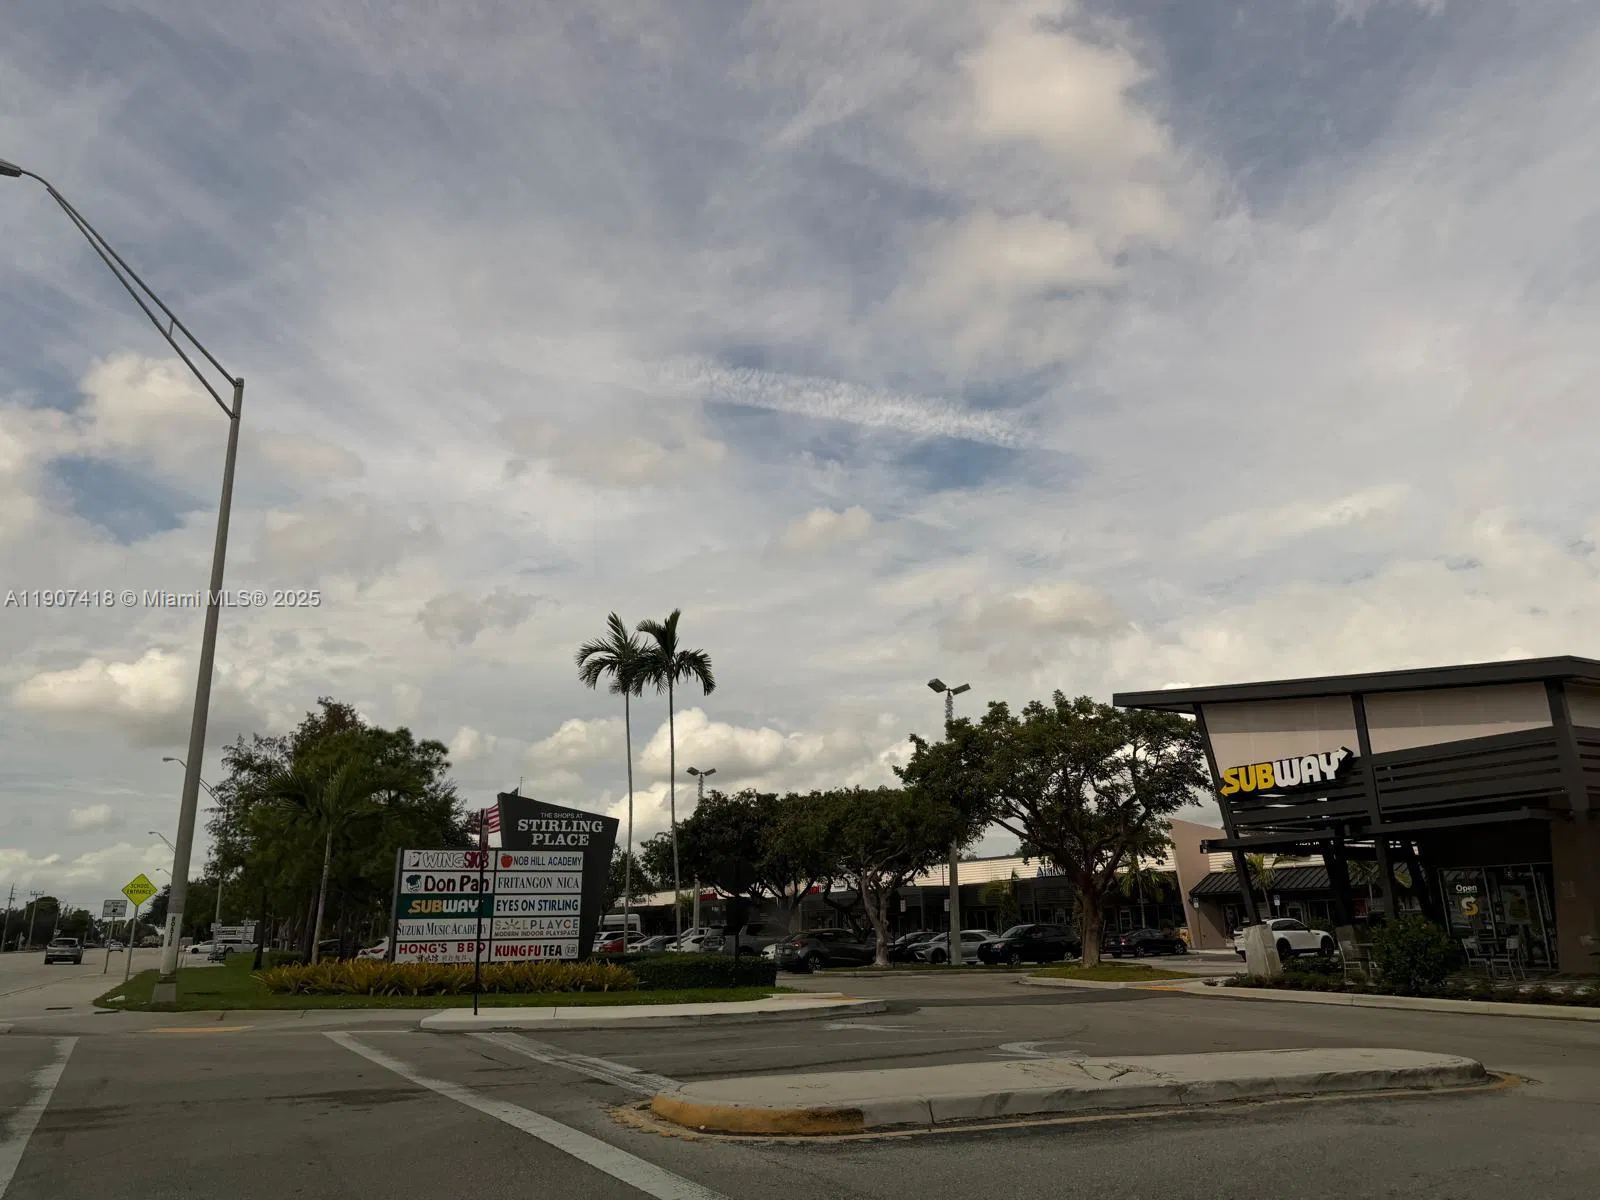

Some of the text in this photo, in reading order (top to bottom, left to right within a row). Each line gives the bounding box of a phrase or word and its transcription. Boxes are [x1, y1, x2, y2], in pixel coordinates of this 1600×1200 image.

[1219, 747, 1349, 796] SUBWAY
[517, 818, 604, 833] STIRLING
[531, 833, 590, 846] PLACE
[513, 856, 582, 866] NOB HILL ACADEMY
[424, 875, 489, 892] Don Pan
[497, 876, 579, 889] FRITANGON NICA
[1455, 884, 1478, 894] Open
[407, 898, 480, 914] SUBWAY
[496, 899, 578, 911] EYES ON STIRLING
[396, 922, 488, 936] SUZUKI MUSIC ACADEY
[399, 943, 447, 954] HONG'S
[495, 945, 526, 957] KUNG
[528, 945, 541, 957] FU
[543, 945, 562, 957] TEA
